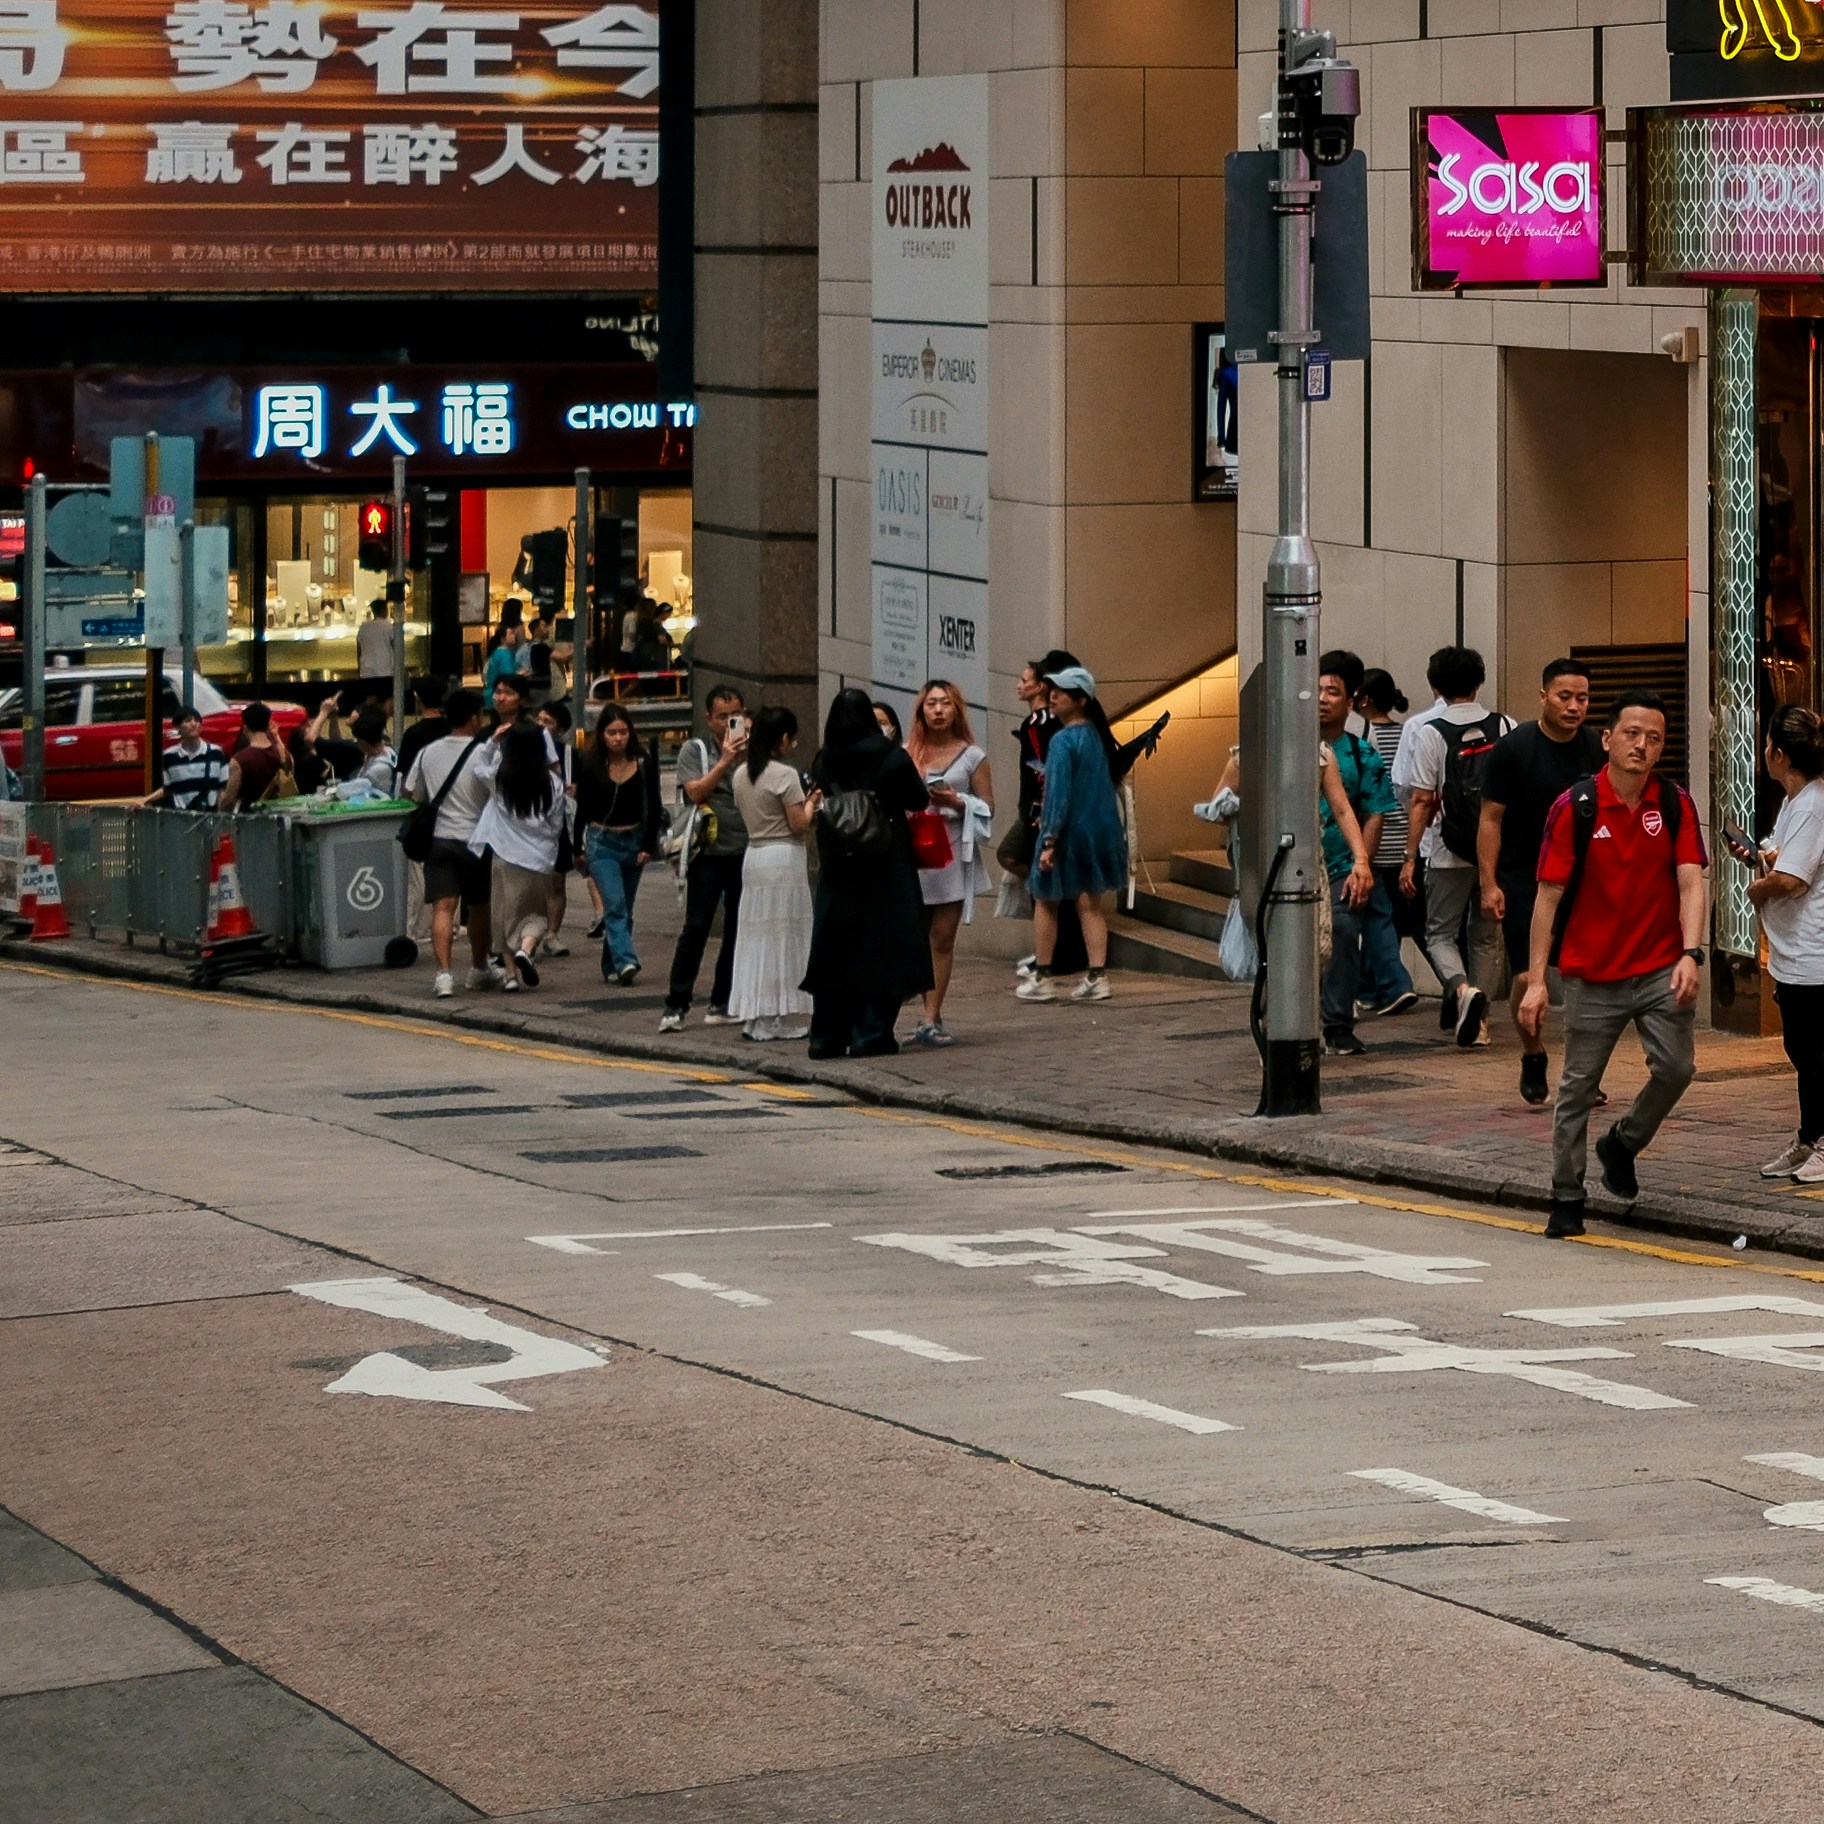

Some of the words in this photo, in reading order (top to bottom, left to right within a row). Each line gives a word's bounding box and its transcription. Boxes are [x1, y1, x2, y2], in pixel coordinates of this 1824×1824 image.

[1436, 153, 1591, 216] Sasa
[886, 185, 971, 229] OUTBACK
[1446, 223, 1498, 245] making
[1502, 222, 1521, 244] life
[1524, 221, 1582, 241] beautiful
[882, 354, 919, 379] EMPEROR
[938, 358, 976, 384] CINEMAS
[253, 383, 513, 458] 周大福
[567, 403, 657, 431] CHOW
[879, 468, 920, 515] OASIS
[939, 614, 975, 653] XENTER
